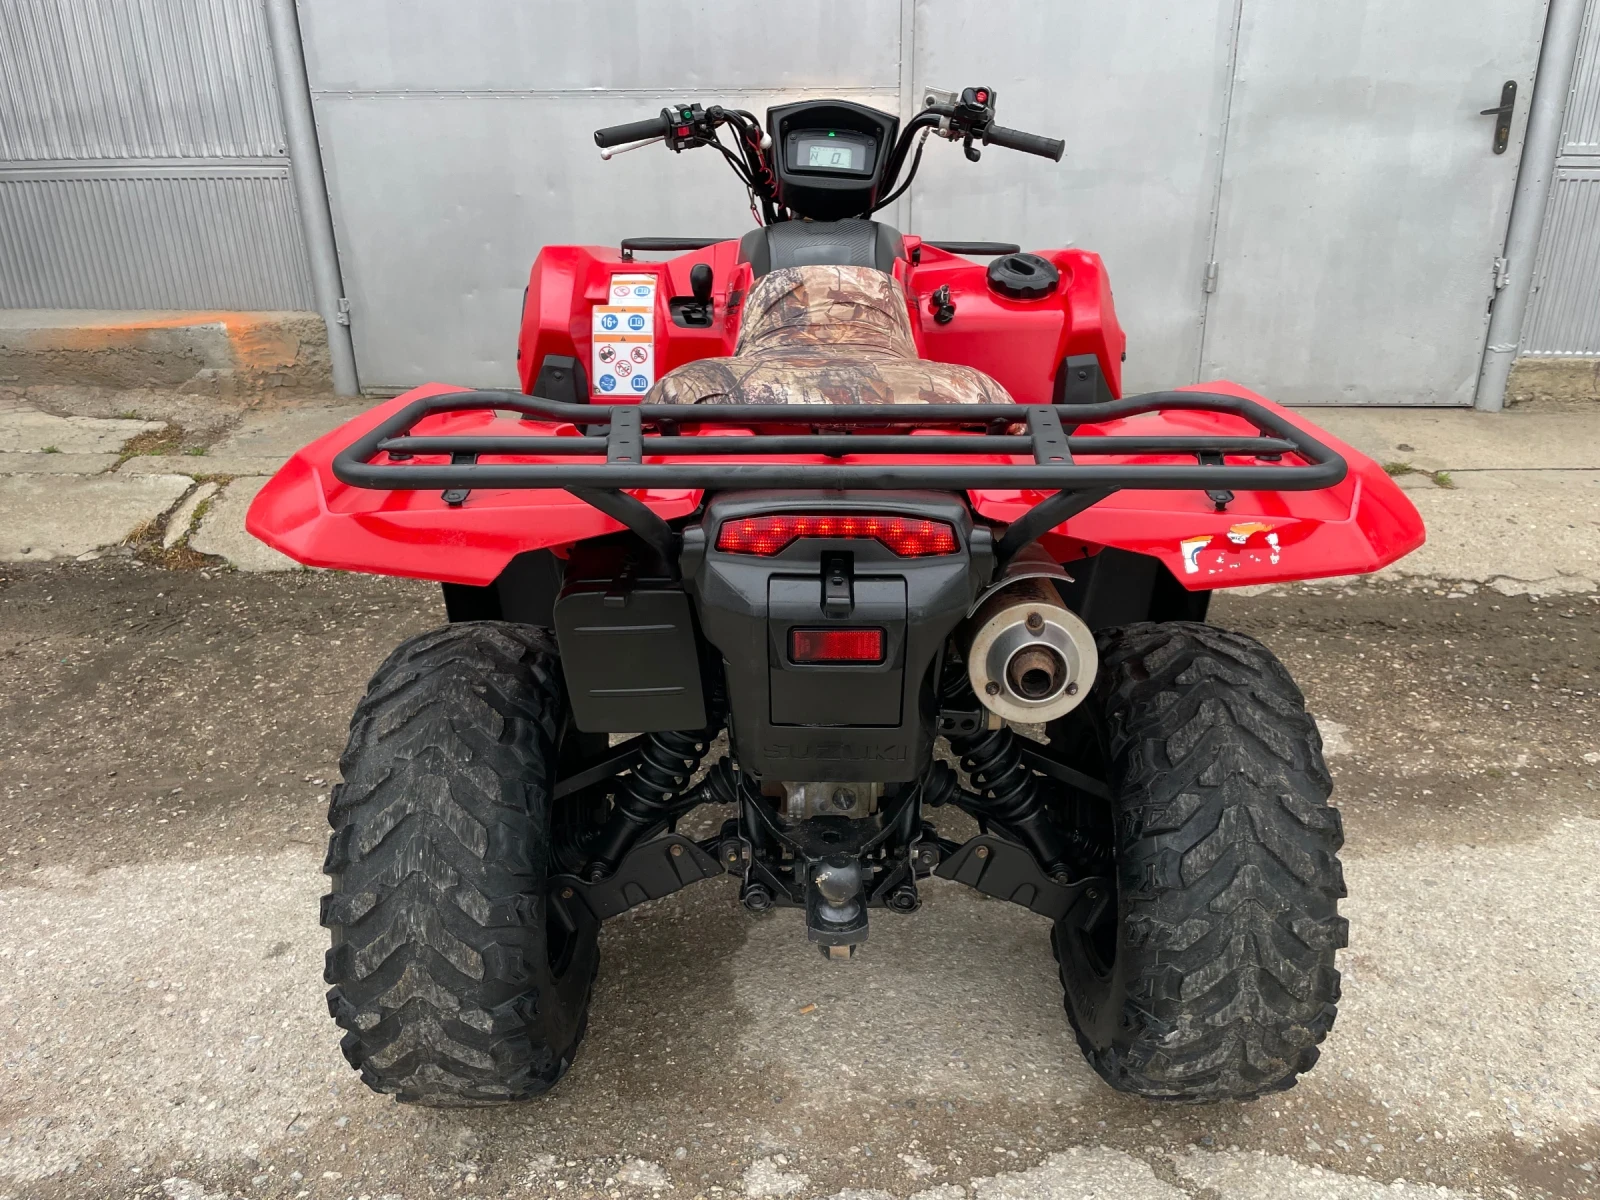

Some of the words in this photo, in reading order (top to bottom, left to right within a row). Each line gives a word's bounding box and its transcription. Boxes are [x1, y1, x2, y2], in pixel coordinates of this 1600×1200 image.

[810, 151, 819, 161] N
[830, 152, 842, 165] 0
[602, 316, 618, 328] 16+
[763, 743, 907, 762] SUZUKI
